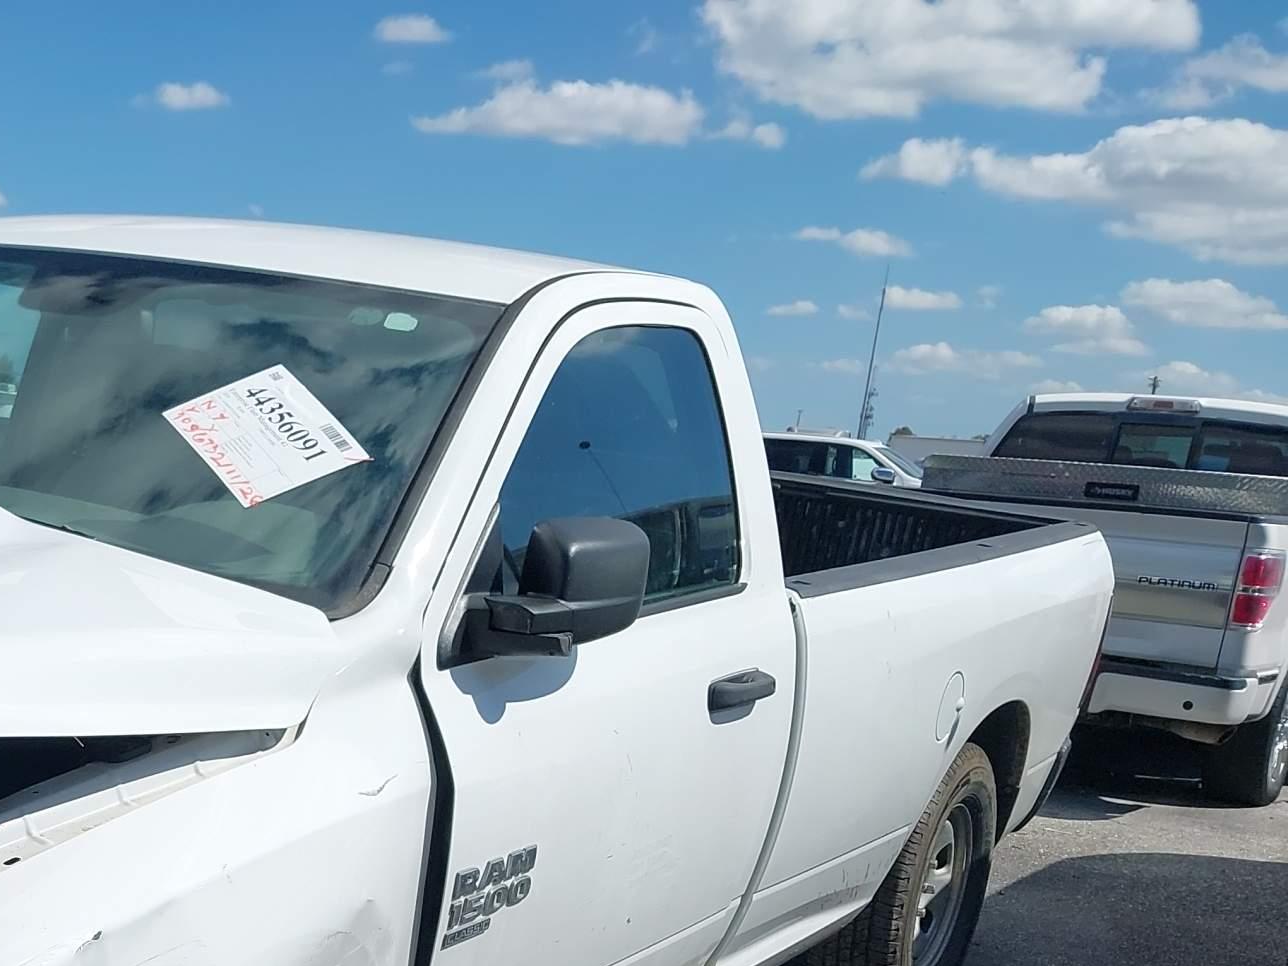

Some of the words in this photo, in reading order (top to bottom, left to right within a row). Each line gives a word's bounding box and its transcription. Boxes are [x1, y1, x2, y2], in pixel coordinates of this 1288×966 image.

[245, 387, 328, 461] 44356091
[1137, 575, 1218, 592] PLATINUM
[452, 844, 537, 901] RAM
[446, 875, 531, 931] 1500
